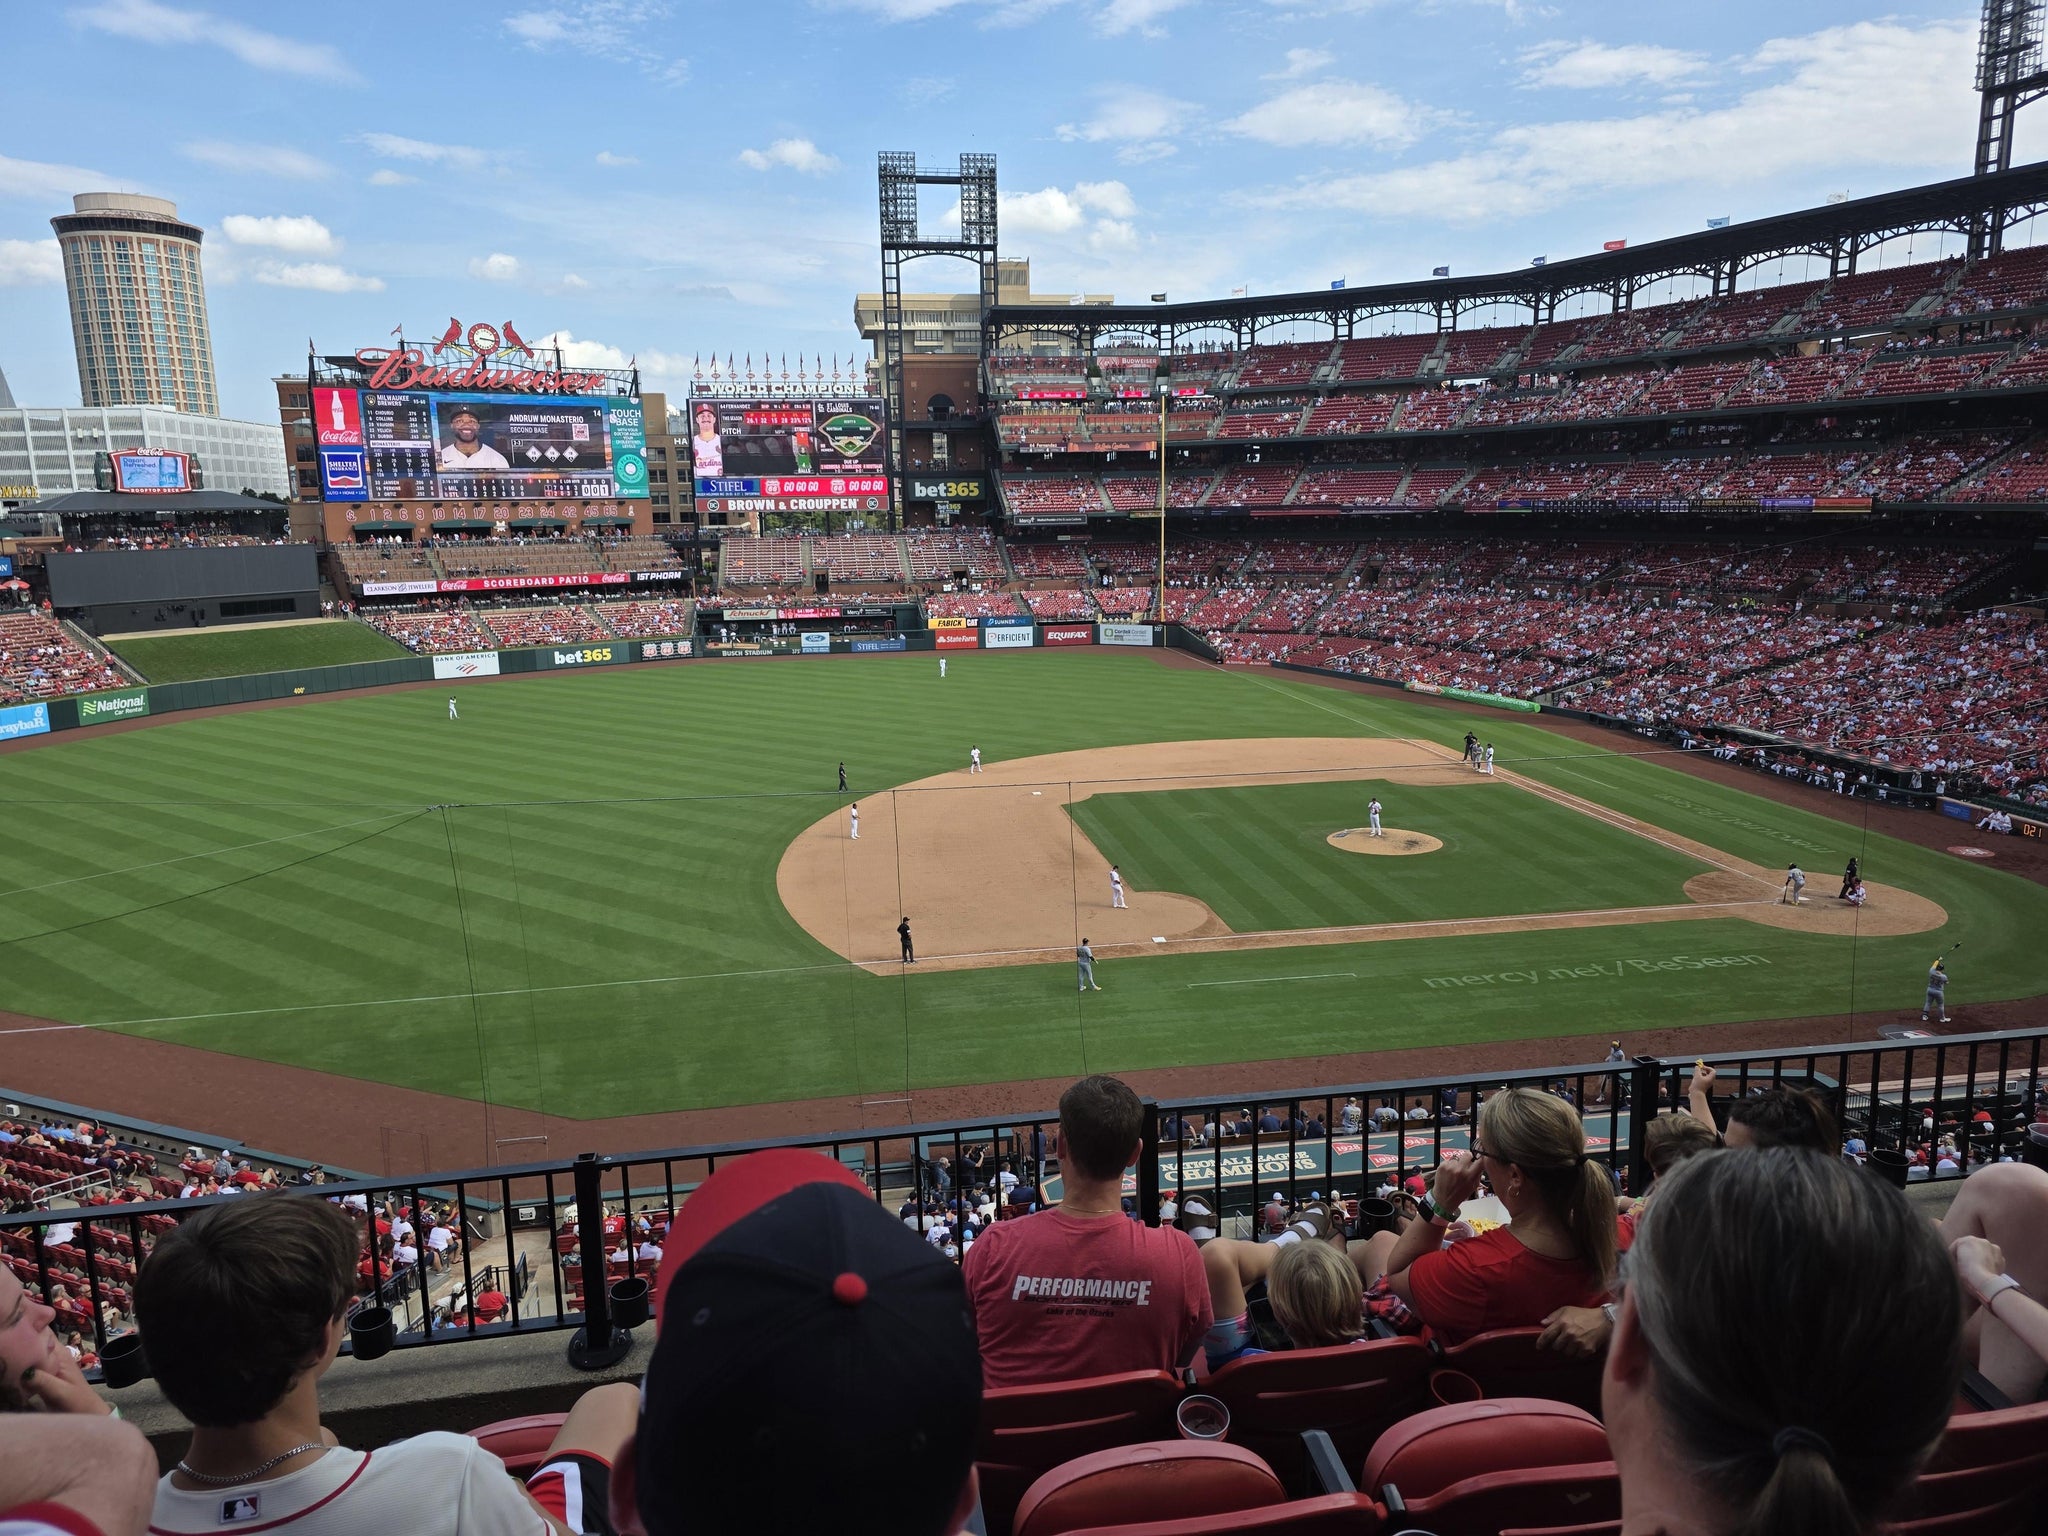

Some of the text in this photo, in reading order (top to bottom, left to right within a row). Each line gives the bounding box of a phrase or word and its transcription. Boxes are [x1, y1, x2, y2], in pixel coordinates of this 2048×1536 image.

[356, 347, 606, 392] Budweiser
[710, 384, 864, 394] WORLD CHAMPIONS
[611, 409, 641, 417] TOUCH
[616, 418, 638, 426] BASE
[321, 430, 360, 443] Coca-Cola
[137, 447, 164, 456] Coca-Cola
[0, 486, 39, 498] MOKE
[710, 480, 747, 492] STIFEL
[784, 482, 819, 492] GO GO GO
[849, 481, 883, 491] GO GO GO
[914, 482, 979, 497] bet365
[728, 499, 857, 510] BROWN & CROUPPEN
[370, 506, 618, 520] 1 2 6 9 10 14 17 20 23 24 42 45 85
[601, 573, 625, 583] Coca-Cola
[650, 571, 681, 580] PHORM
[441, 580, 468, 590] Coca-Cola
[484, 576, 588, 588] SCOREBOARD PATIO
[988, 633, 1030, 643] PERFICIENT
[1048, 631, 1087, 641] EQUIFAX
[554, 648, 612, 665] bet365
[97, 695, 144, 712] National
[0, 717, 46, 734] raybaR
[1422, 952, 1772, 988] mercy.net/BeSeen
[1160, 1151, 1310, 1171] NATIONAL LEAGUE
[1164, 1159, 1317, 1182] CHAMPIONS
[1012, 1275, 1152, 1306] PERFORMANCE
[1089, 1308, 1114, 1317] Ozarks
